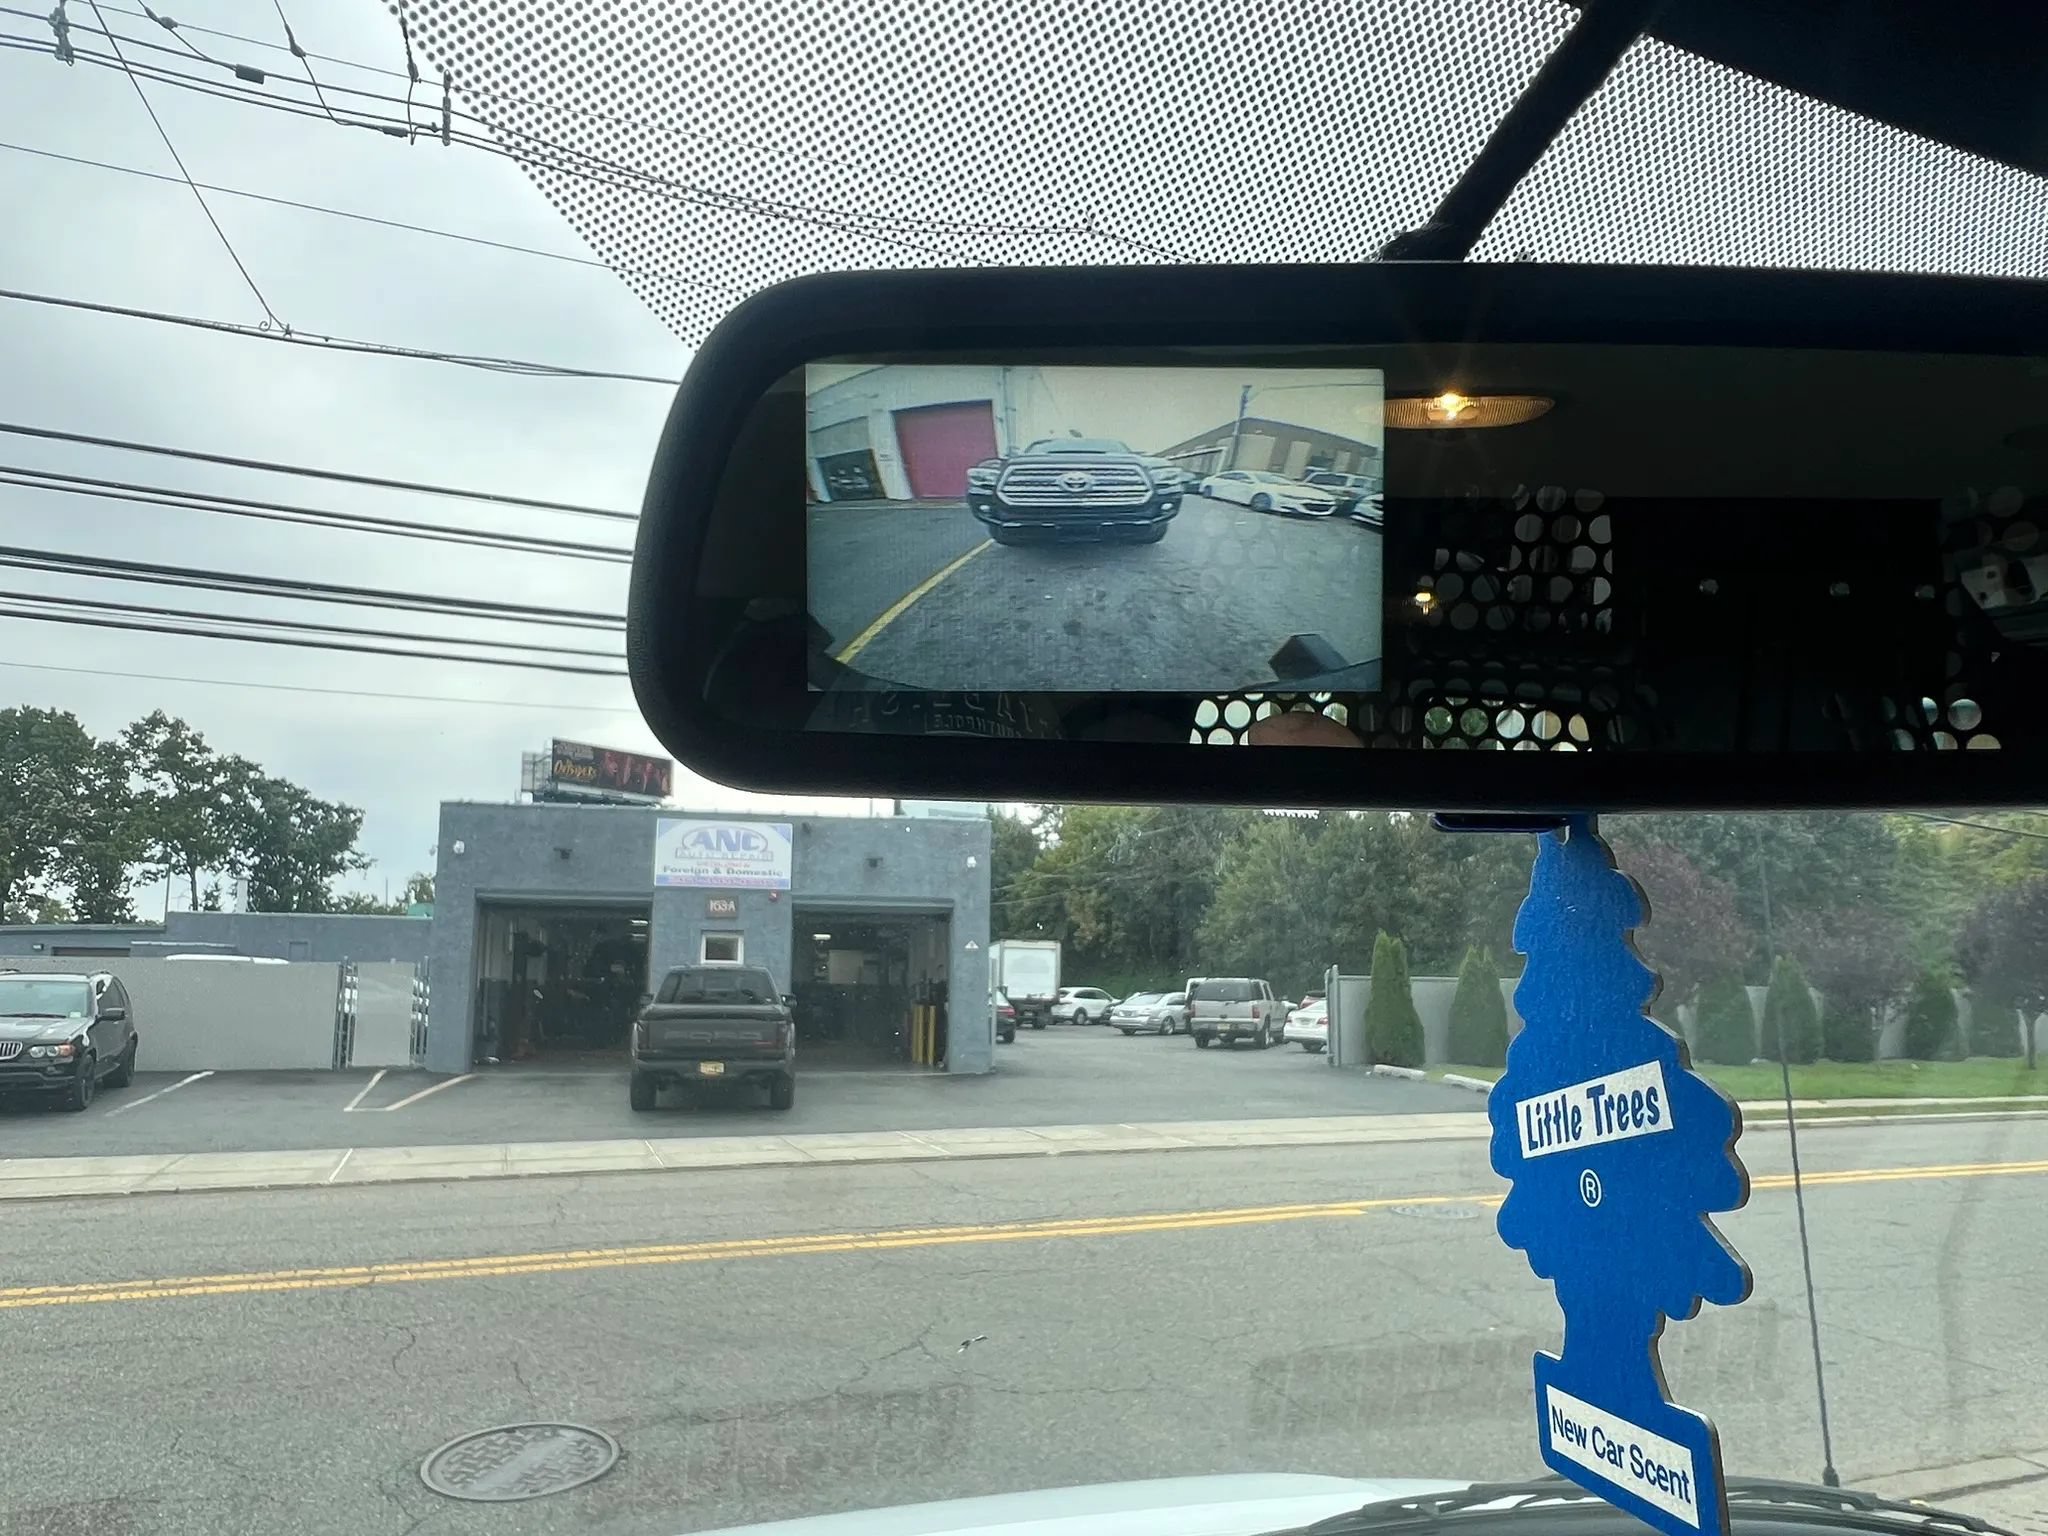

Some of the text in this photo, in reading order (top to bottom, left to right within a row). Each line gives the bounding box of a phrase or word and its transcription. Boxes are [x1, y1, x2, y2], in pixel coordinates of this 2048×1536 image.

[690, 828, 761, 852] ANC
[663, 865, 783, 877] Foreign & Domestic
[1526, 1084, 1661, 1151] Little Trees
[1551, 1405, 1692, 1504] New Car Scent
